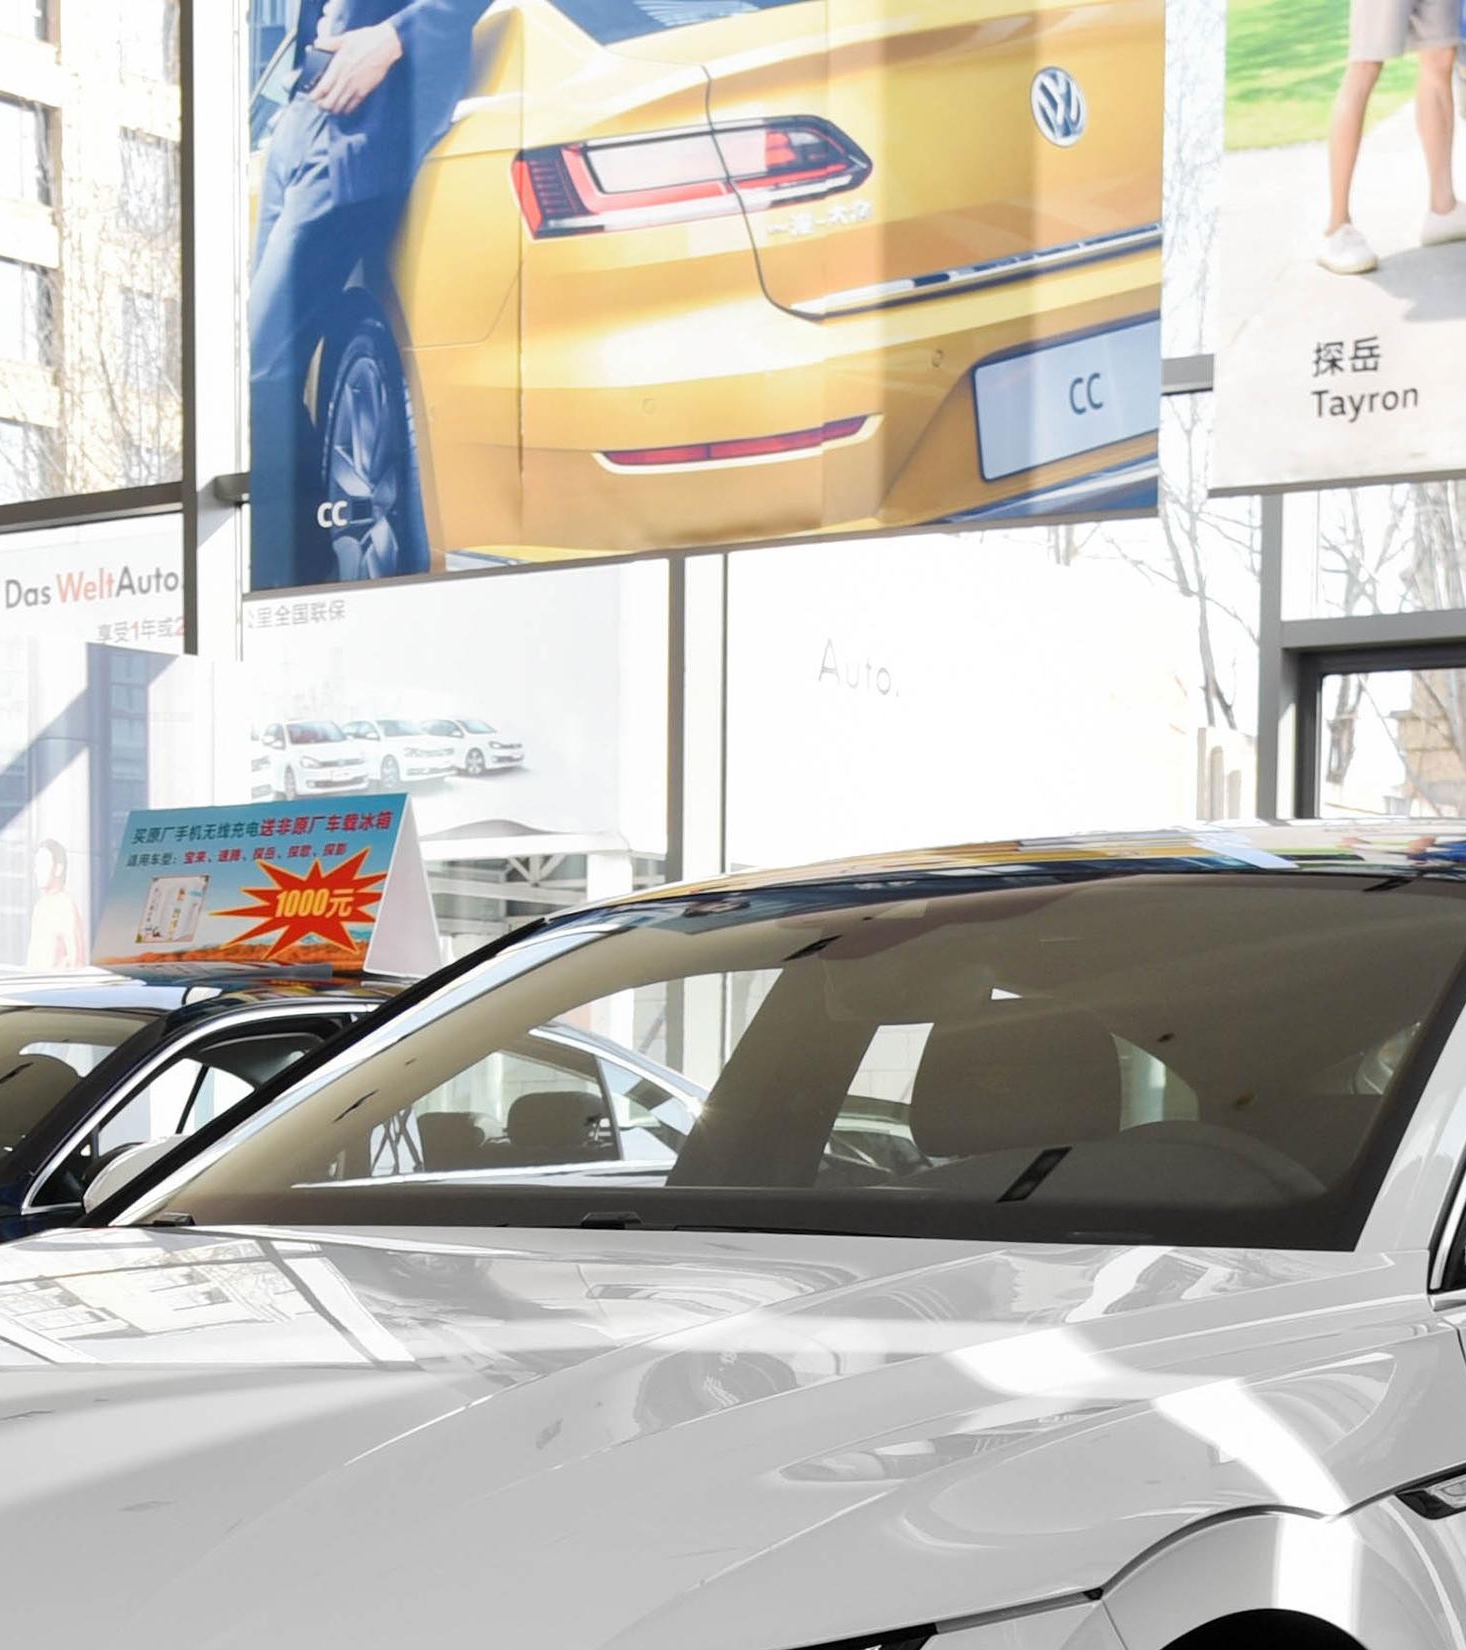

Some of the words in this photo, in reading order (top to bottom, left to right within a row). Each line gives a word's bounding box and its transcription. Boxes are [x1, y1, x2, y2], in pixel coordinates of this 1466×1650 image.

[1312, 336, 1382, 378] 探岳
[1068, 372, 1104, 415] CC
[1310, 387, 1419, 423] Tayron
[316, 500, 349, 529] CC
[4, 579, 51, 609] Das
[275, 887, 355, 919] 1000元
